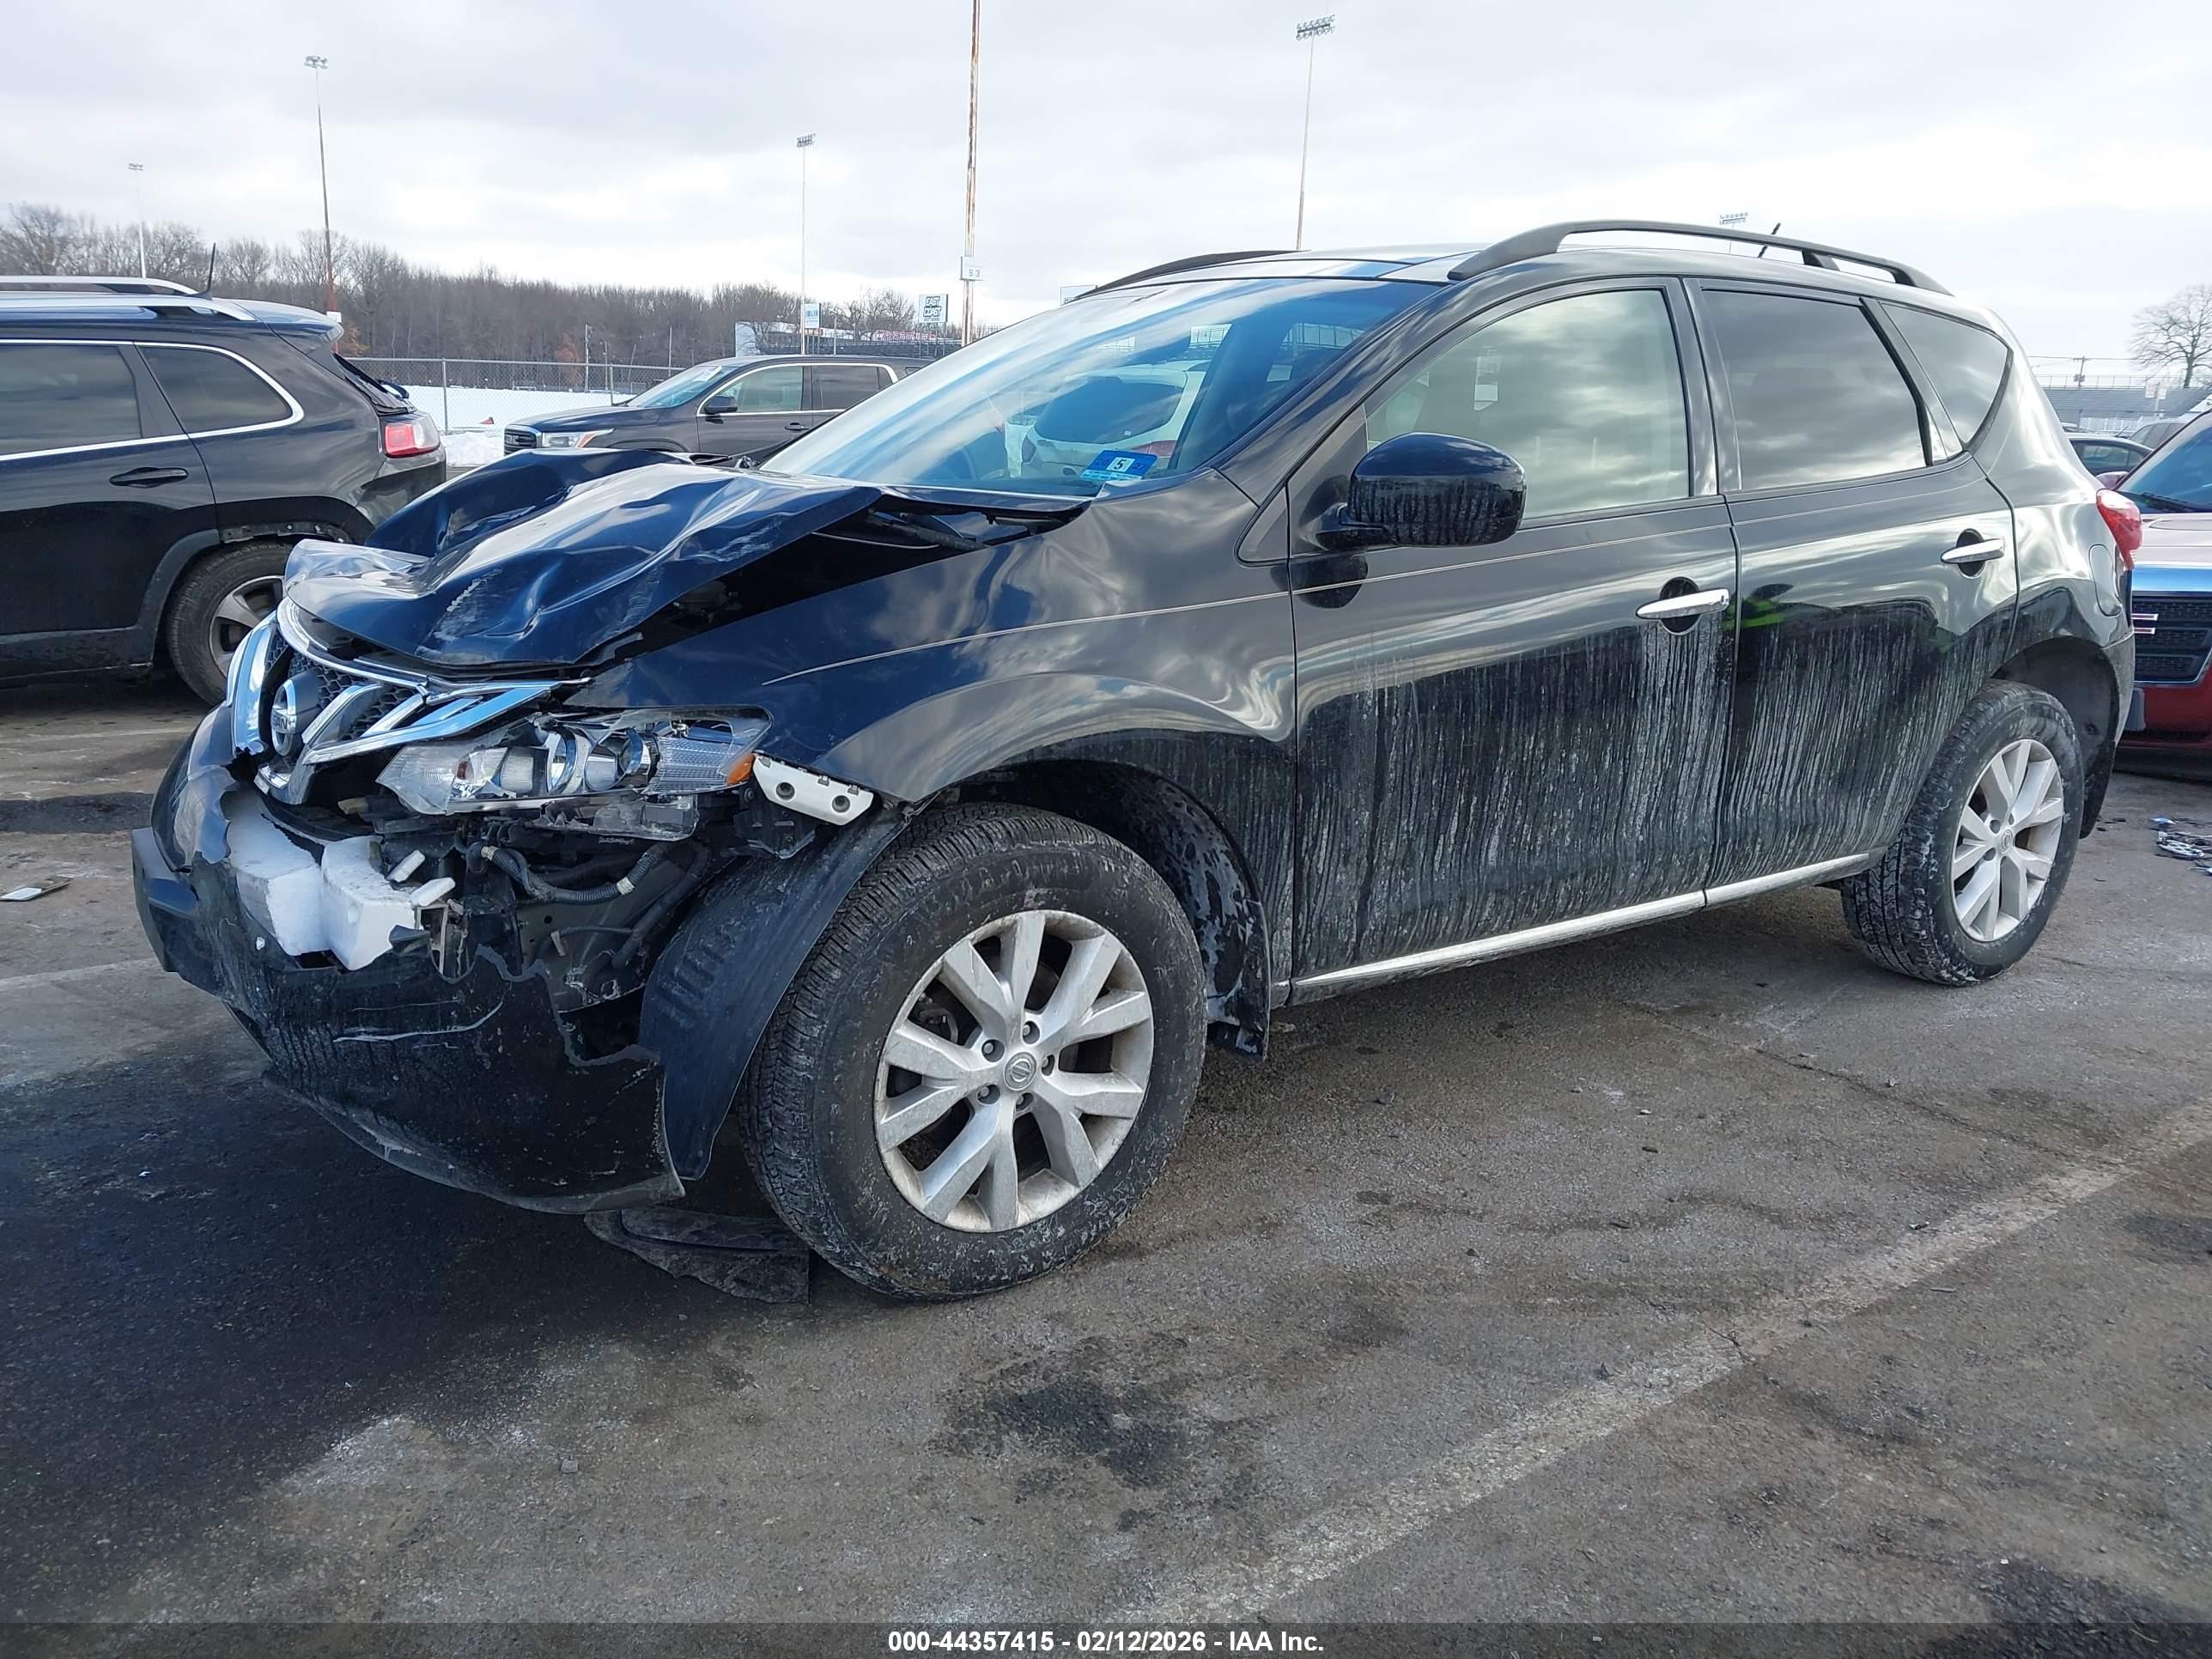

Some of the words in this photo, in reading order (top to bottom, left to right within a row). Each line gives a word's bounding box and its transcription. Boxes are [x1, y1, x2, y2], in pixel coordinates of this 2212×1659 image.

[926, 296, 940, 307] EAST
[923, 307, 942, 317] COAST
[1113, 459, 1127, 470] 5
